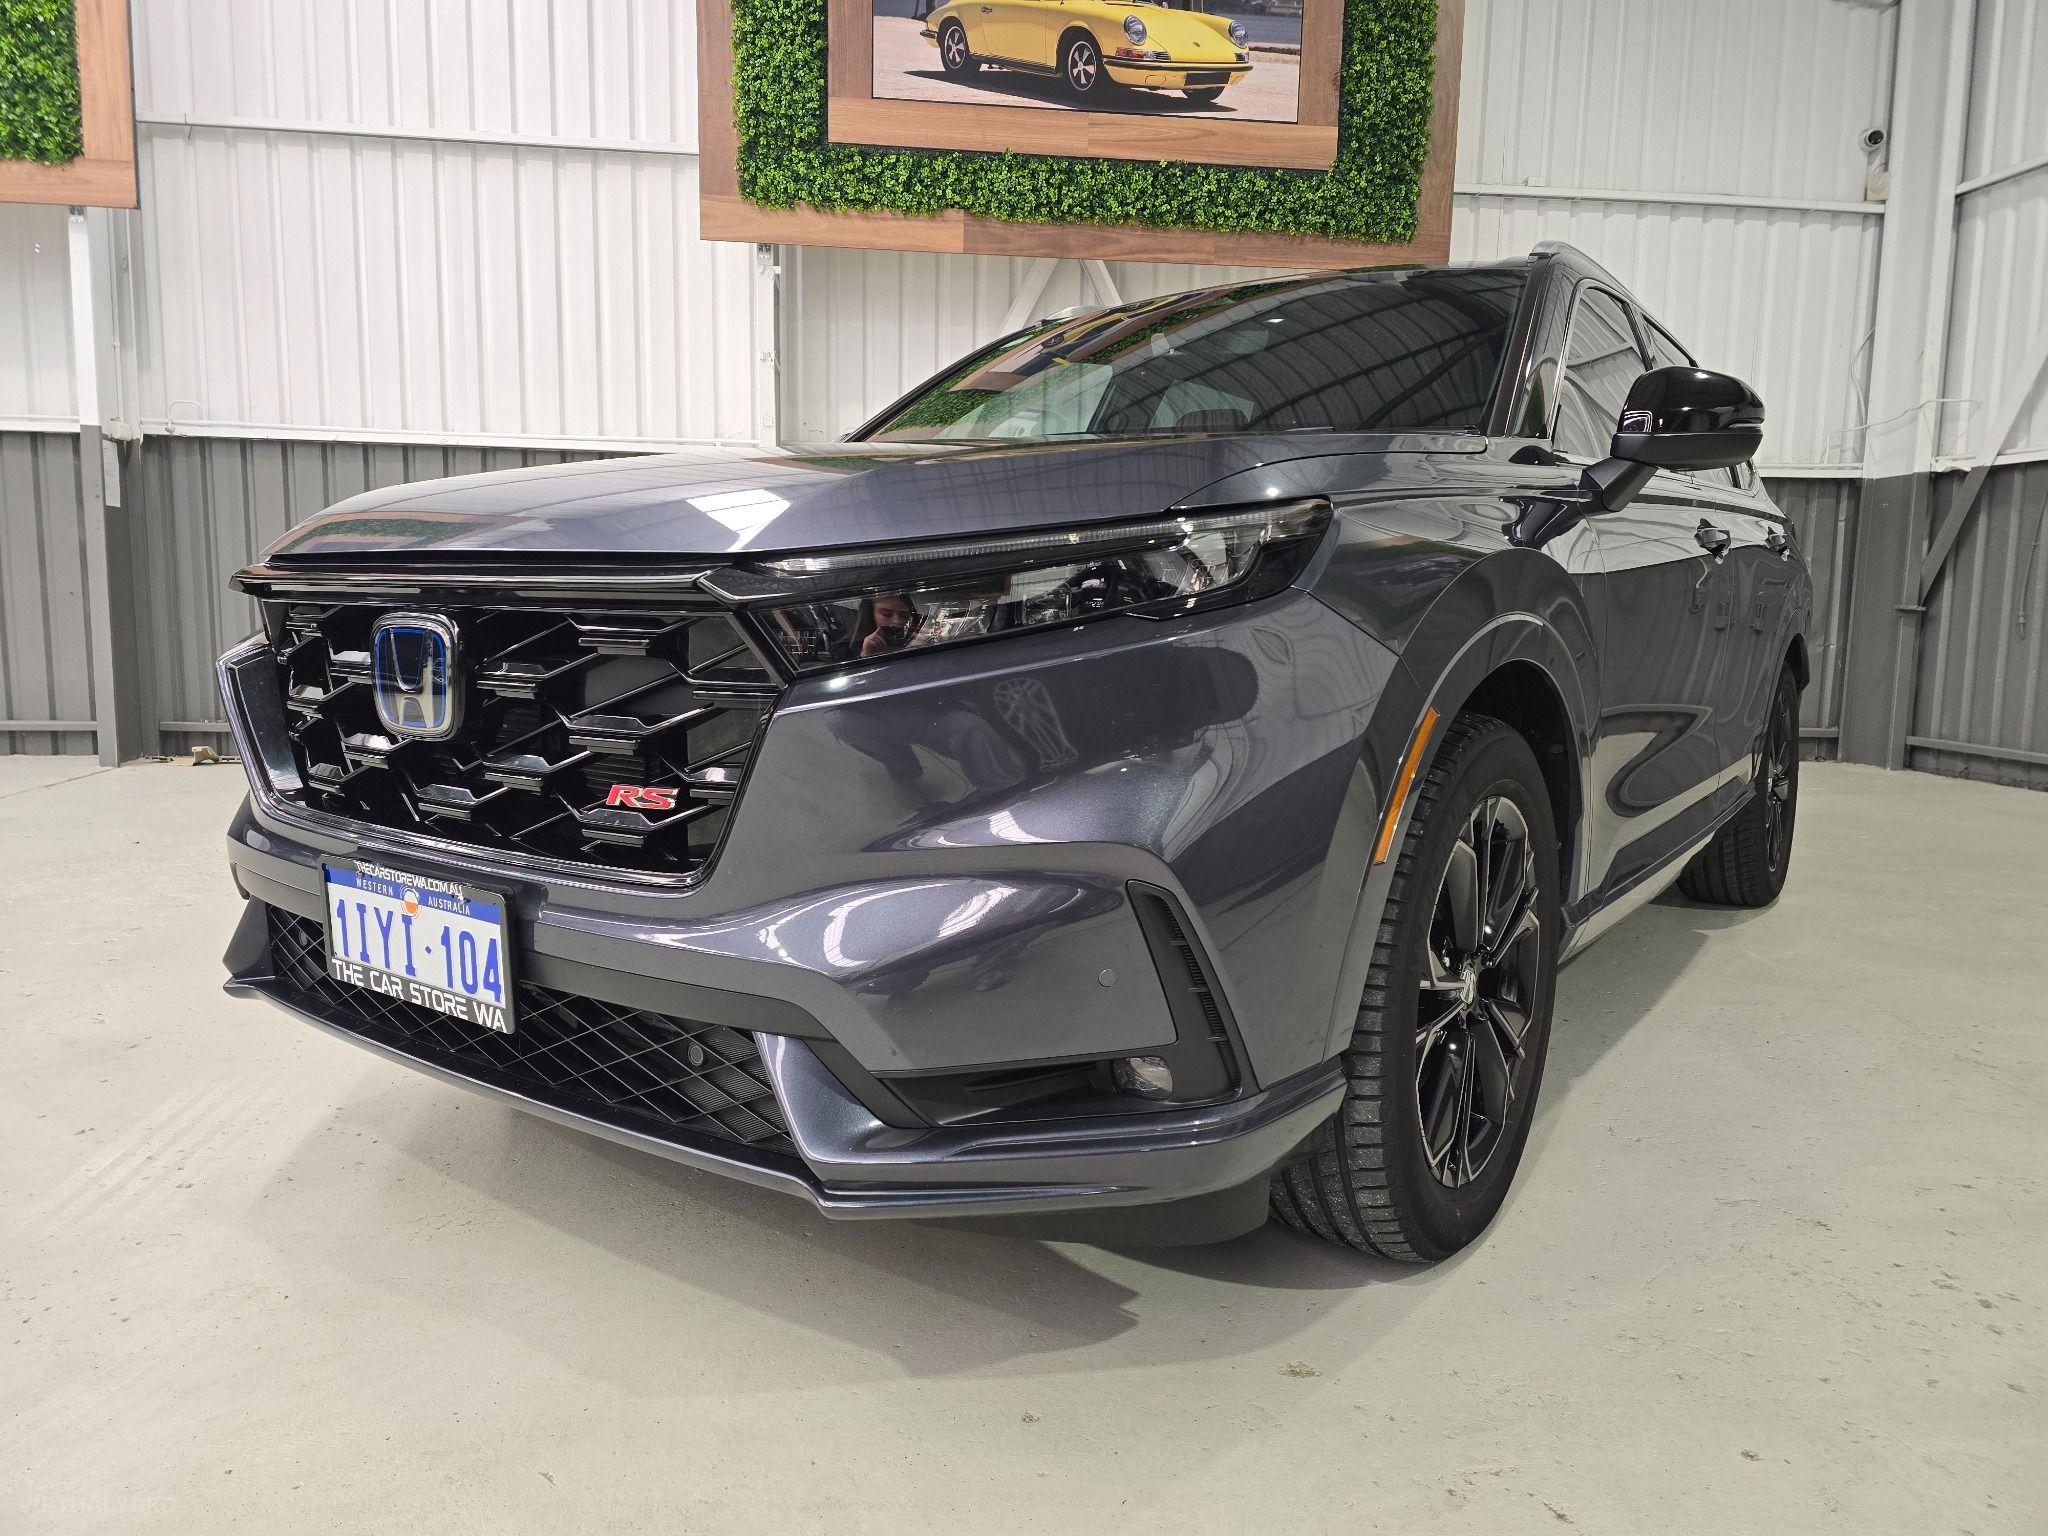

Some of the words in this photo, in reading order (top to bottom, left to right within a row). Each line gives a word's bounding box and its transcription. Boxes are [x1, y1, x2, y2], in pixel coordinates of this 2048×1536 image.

[606, 784, 679, 810] RS
[356, 878, 393, 896] WESTERN
[428, 896, 470, 916] AUSTRALIA
[332, 958, 364, 987] THE
[370, 970, 404, 999] CAR
[409, 982, 468, 1020] STORE
[472, 1001, 507, 1031] WA
